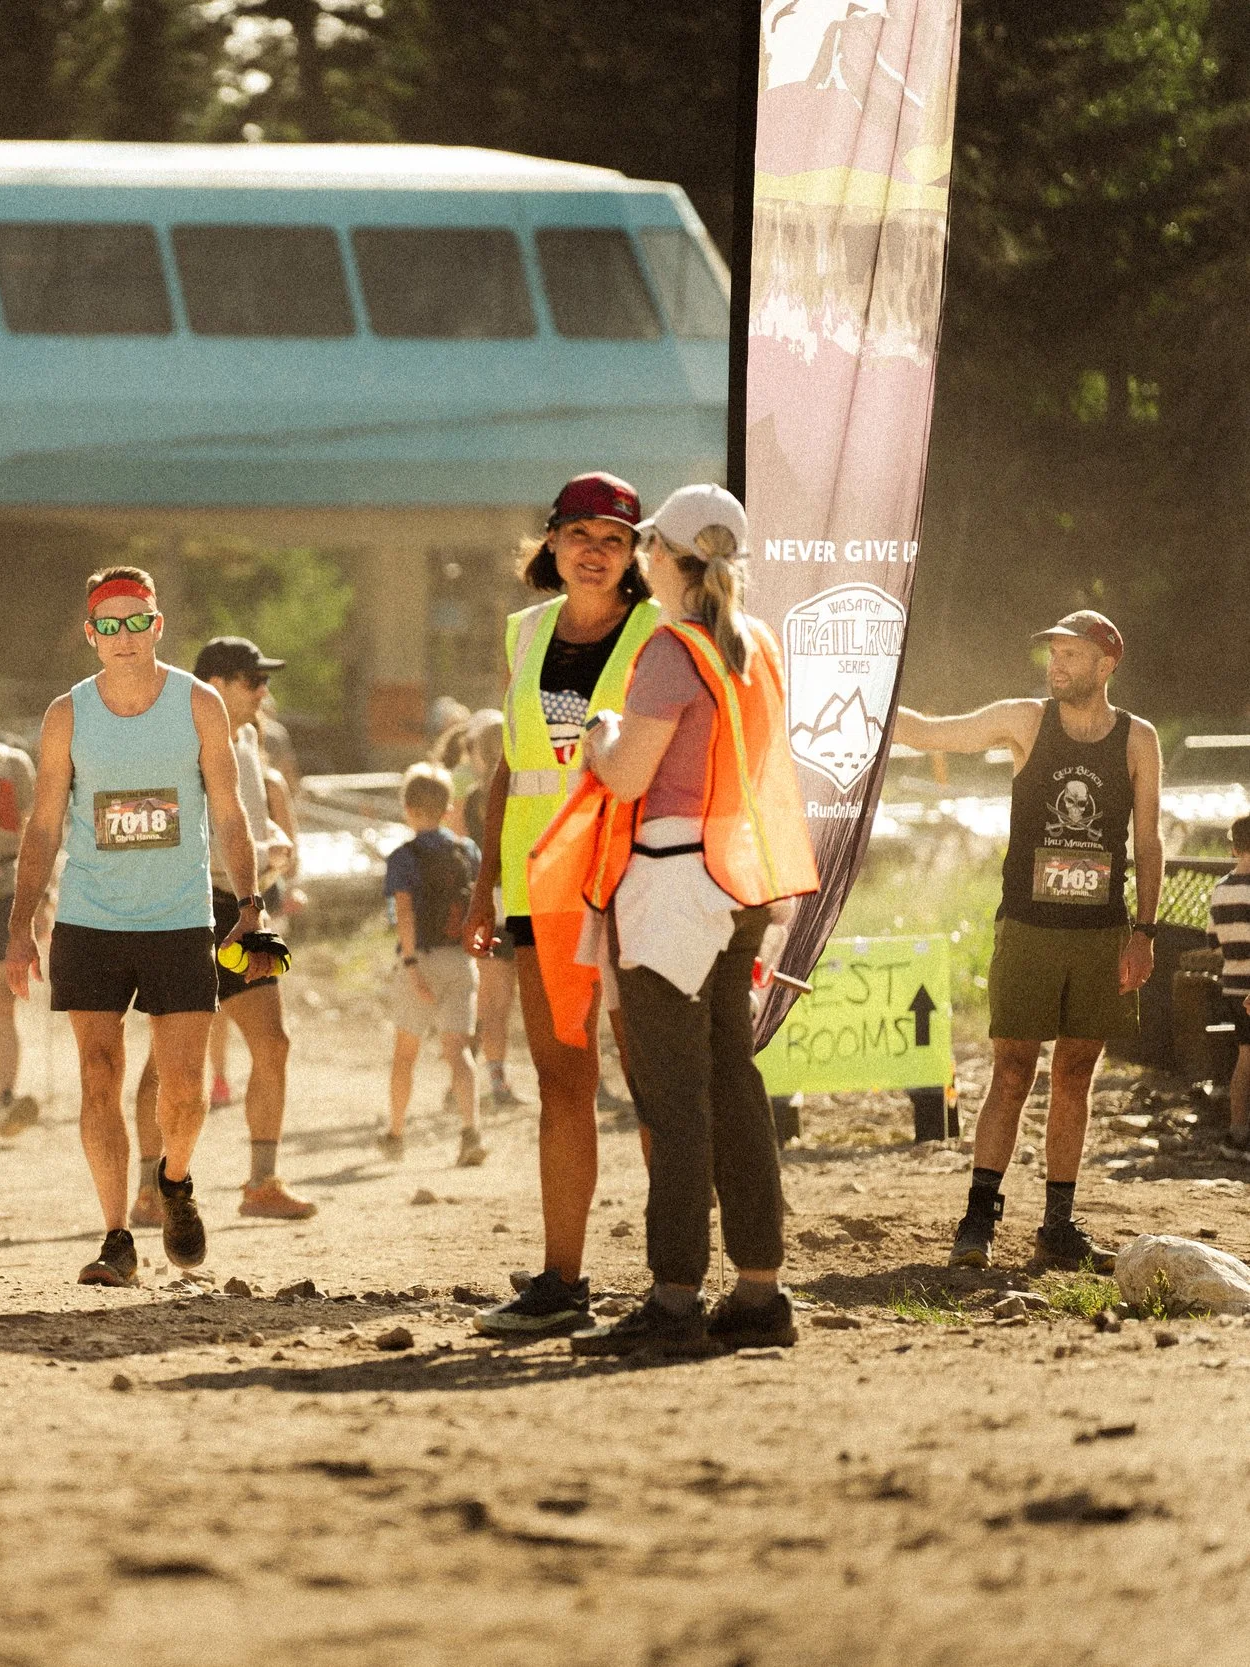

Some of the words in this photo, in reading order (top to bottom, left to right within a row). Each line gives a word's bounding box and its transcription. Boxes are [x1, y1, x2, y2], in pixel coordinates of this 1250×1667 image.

[765, 539, 837, 562] NEVER
[845, 540, 898, 562] GIVE
[828, 598, 882, 615] WASATCH
[791, 612, 862, 656] TRAIL
[838, 660, 870, 674] SERIES
[107, 810, 167, 835] 7018
[1045, 867, 1099, 890] 7103
[801, 961, 912, 1014] EST
[787, 1017, 912, 1065] ROOMS
